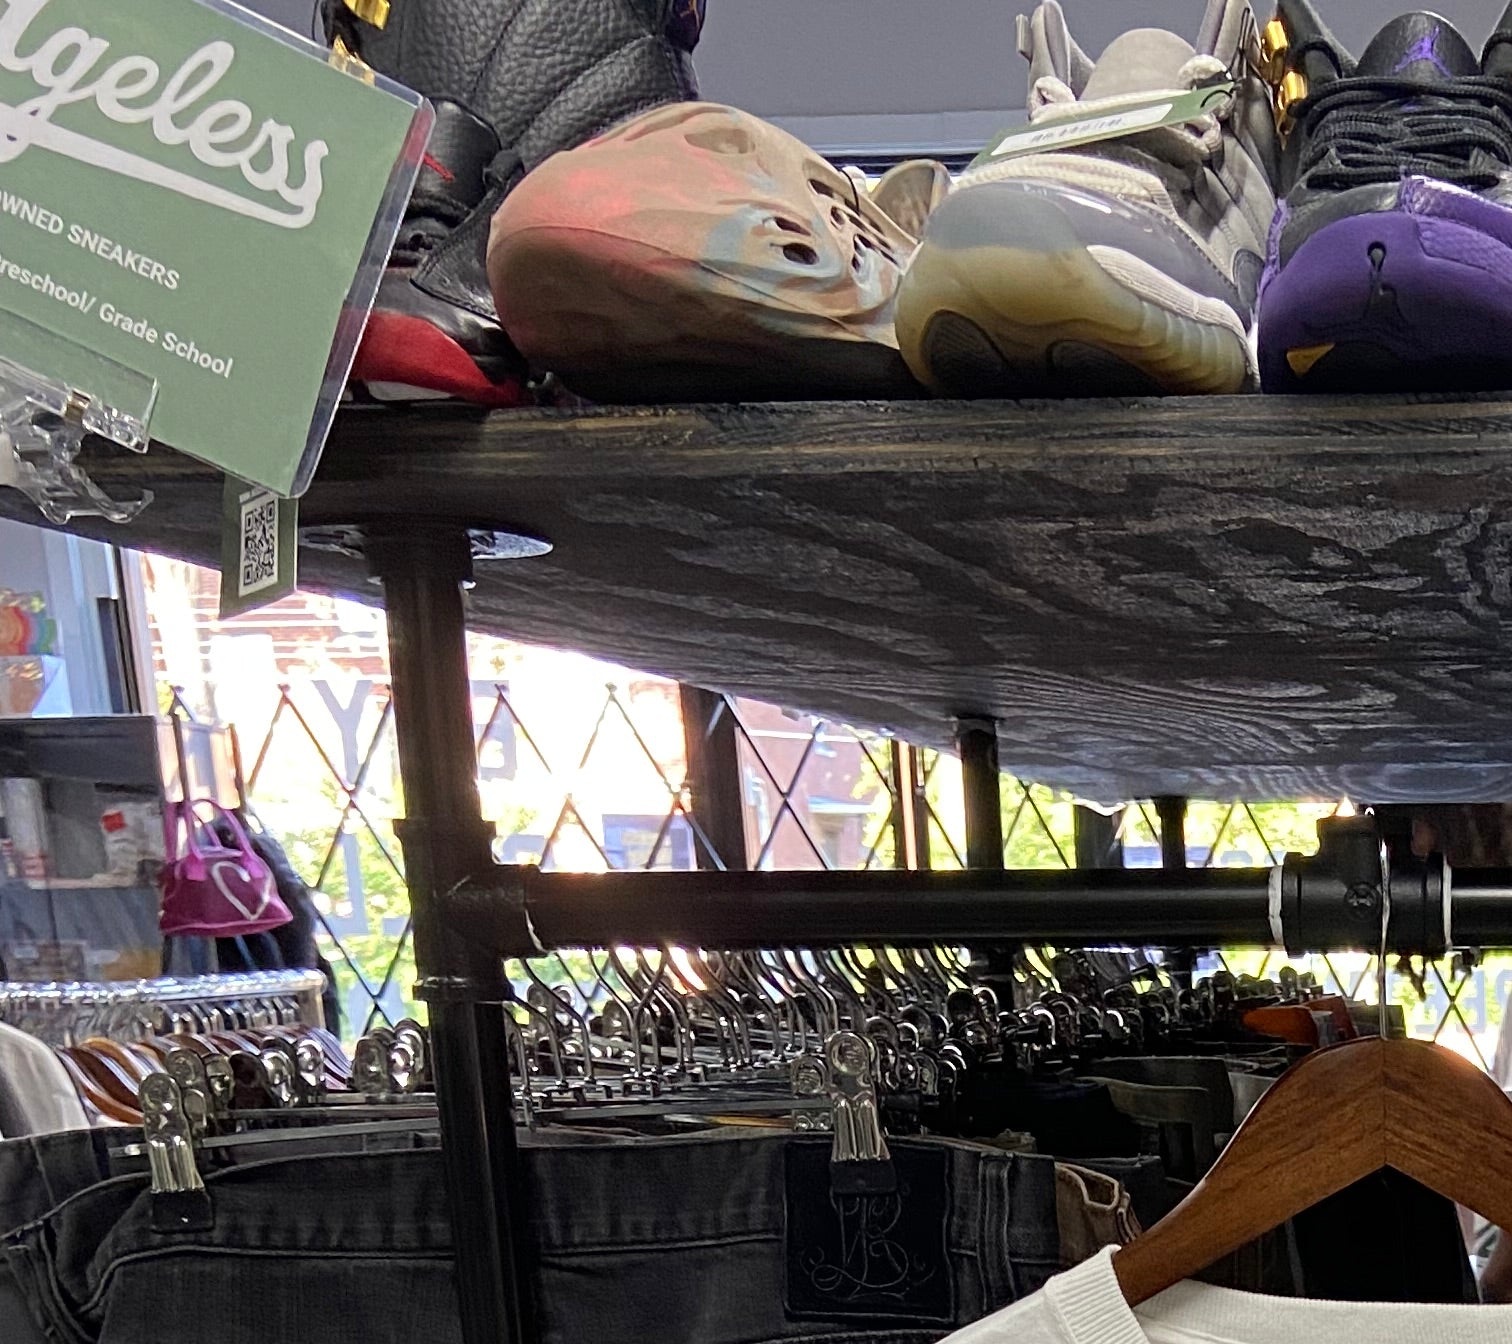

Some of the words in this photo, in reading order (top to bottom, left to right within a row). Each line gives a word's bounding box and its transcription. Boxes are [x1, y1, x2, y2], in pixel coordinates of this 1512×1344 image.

[0, 190, 64, 235] WNED
[67, 224, 180, 290] SNEAKERS
[0, 256, 97, 314] reschool/
[99, 302, 159, 344] Grade
[161, 331, 234, 379] School
